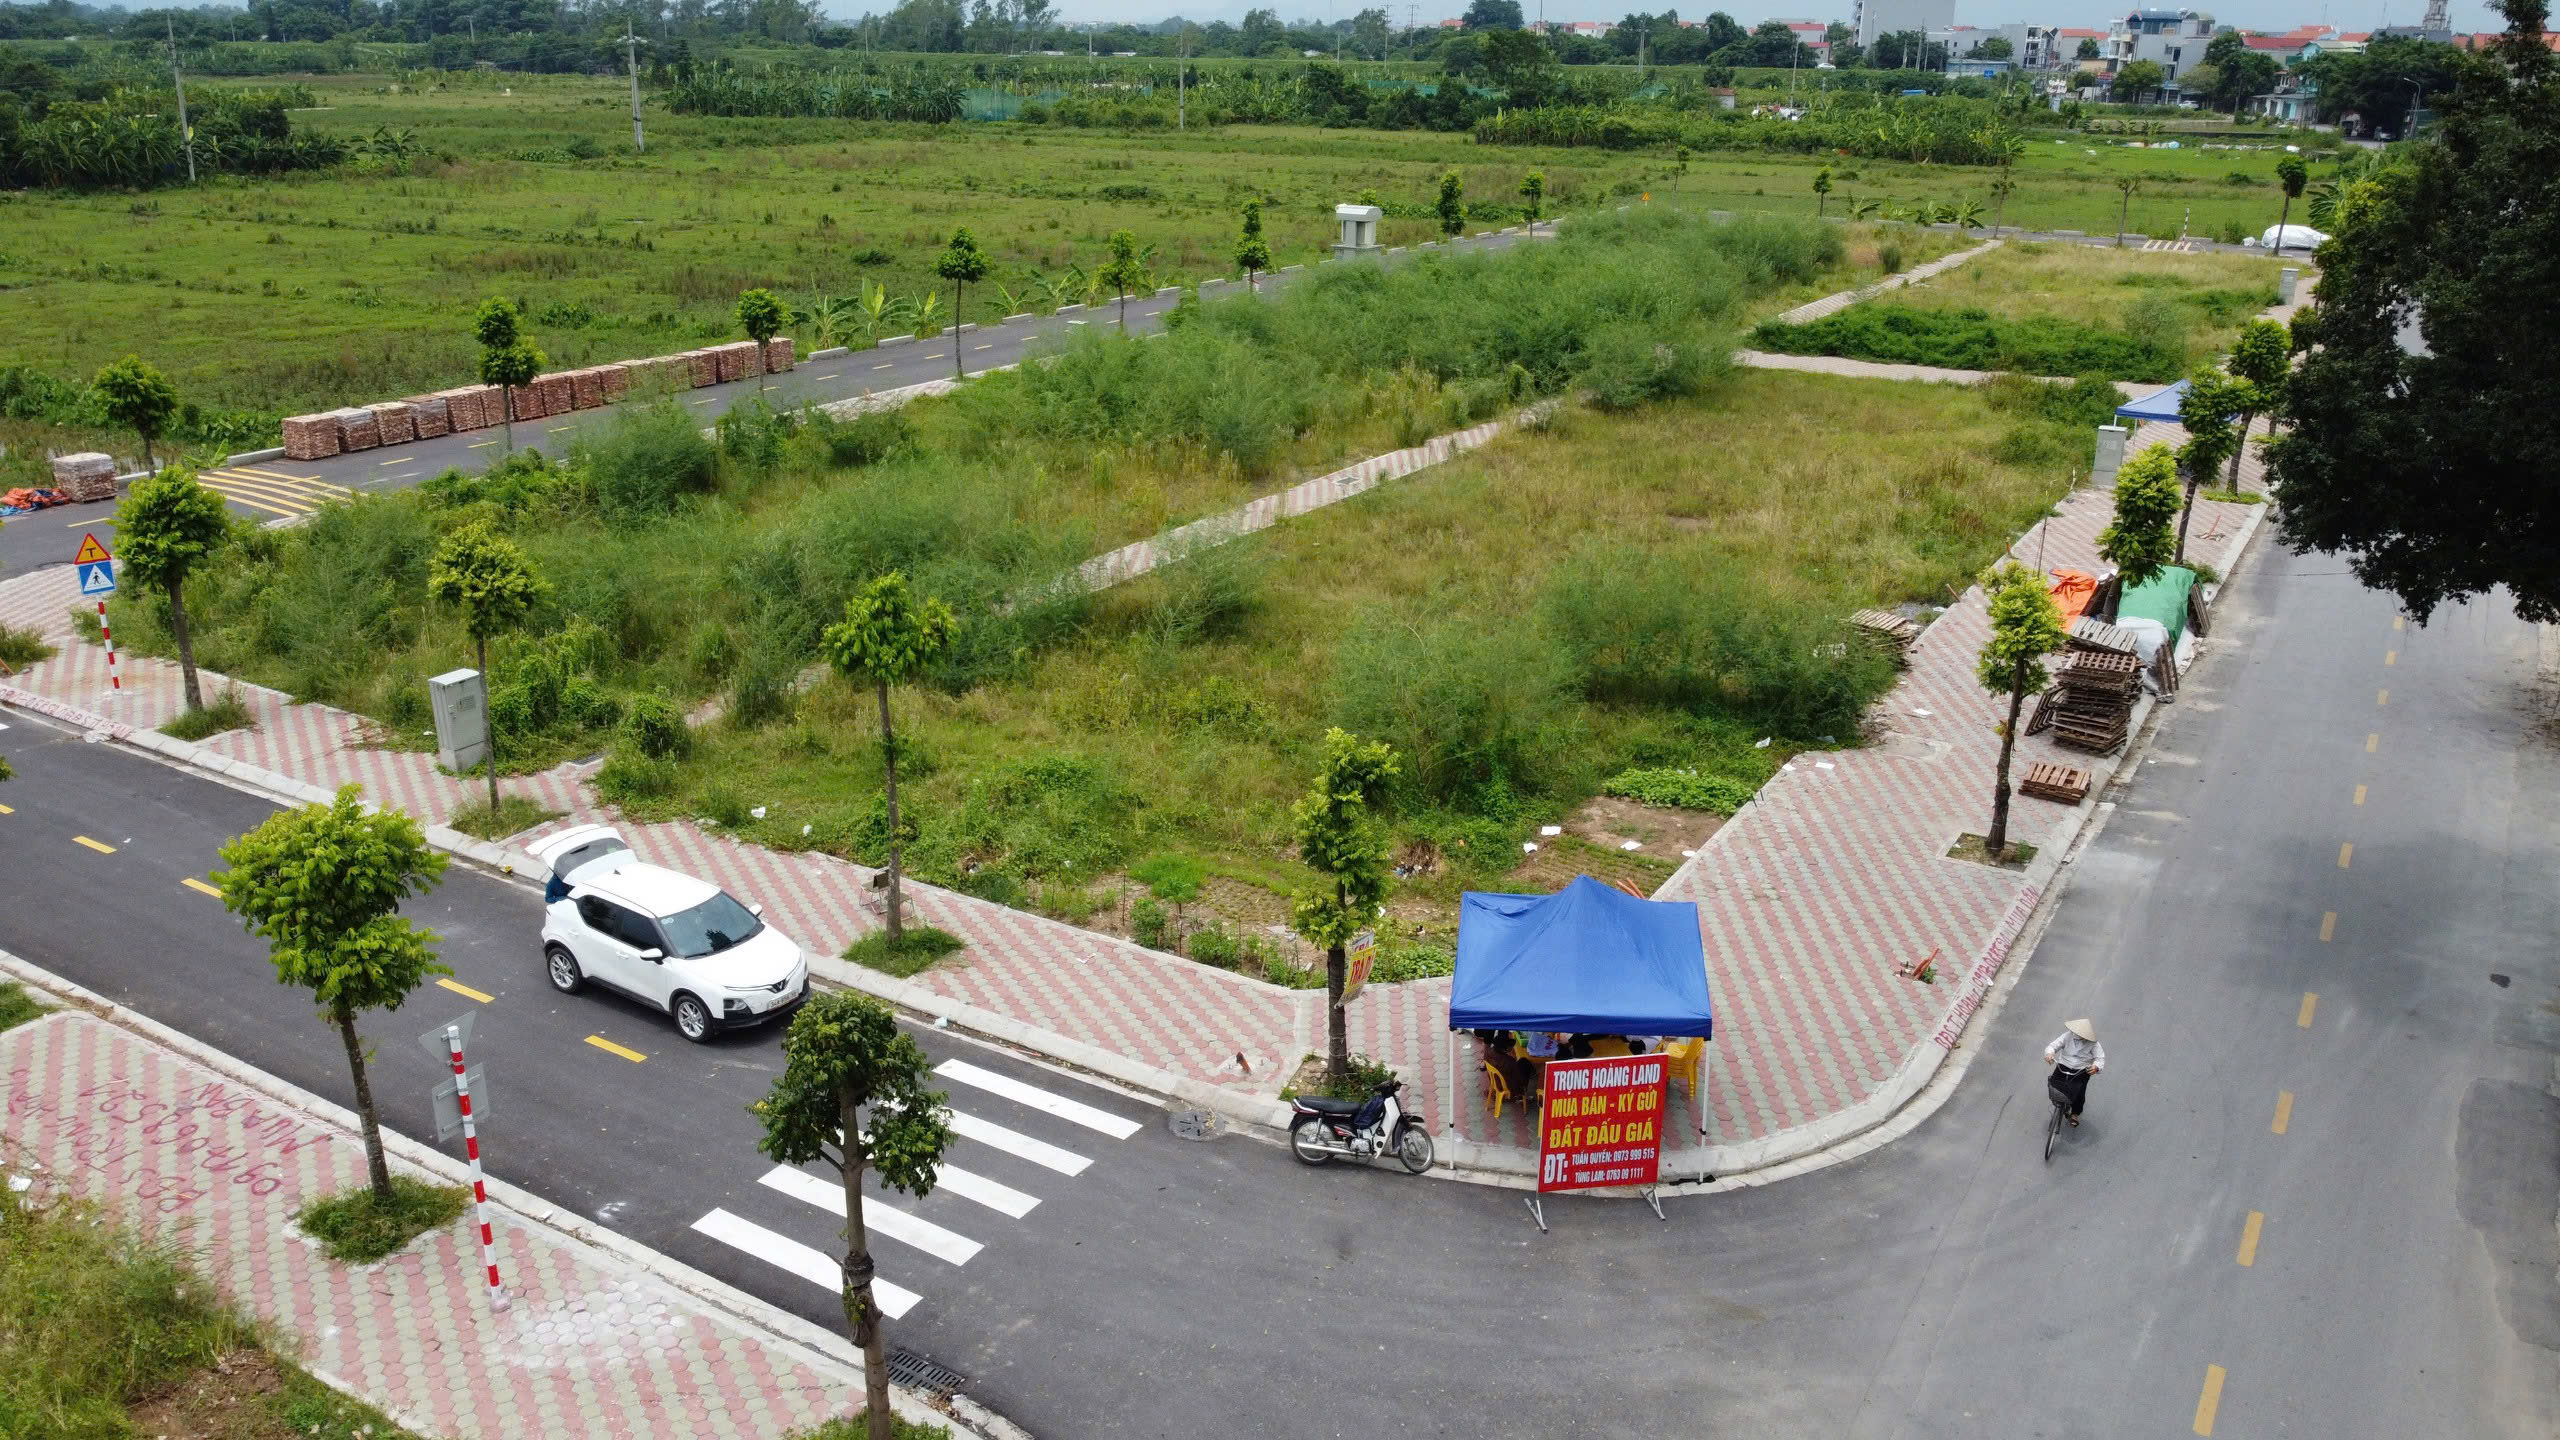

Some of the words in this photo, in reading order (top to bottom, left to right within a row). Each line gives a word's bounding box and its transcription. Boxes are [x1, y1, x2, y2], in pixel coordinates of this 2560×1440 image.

[1553, 1068, 1590, 1095] TRỌNG
[1591, 1063, 1630, 1089] HOÀNG
[1631, 1063, 1661, 1086] LAND
[1551, 1097, 1578, 1118] MUA
[1581, 1092, 1607, 1116] BÁN
[1617, 1089, 1635, 1113] KÝ
[1636, 1085, 1658, 1111] GỬI
[1549, 1120, 1583, 1149] ĐẤT
[1586, 1118, 1621, 1145] ĐẤU
[1625, 1117, 1654, 1142] GIÁ
[1543, 1153, 1569, 1184] ĐT:
[1613, 1150, 1629, 1162] 0973
[1642, 1147, 1655, 1159] 515
[1630, 1167, 1644, 1179] 1111
